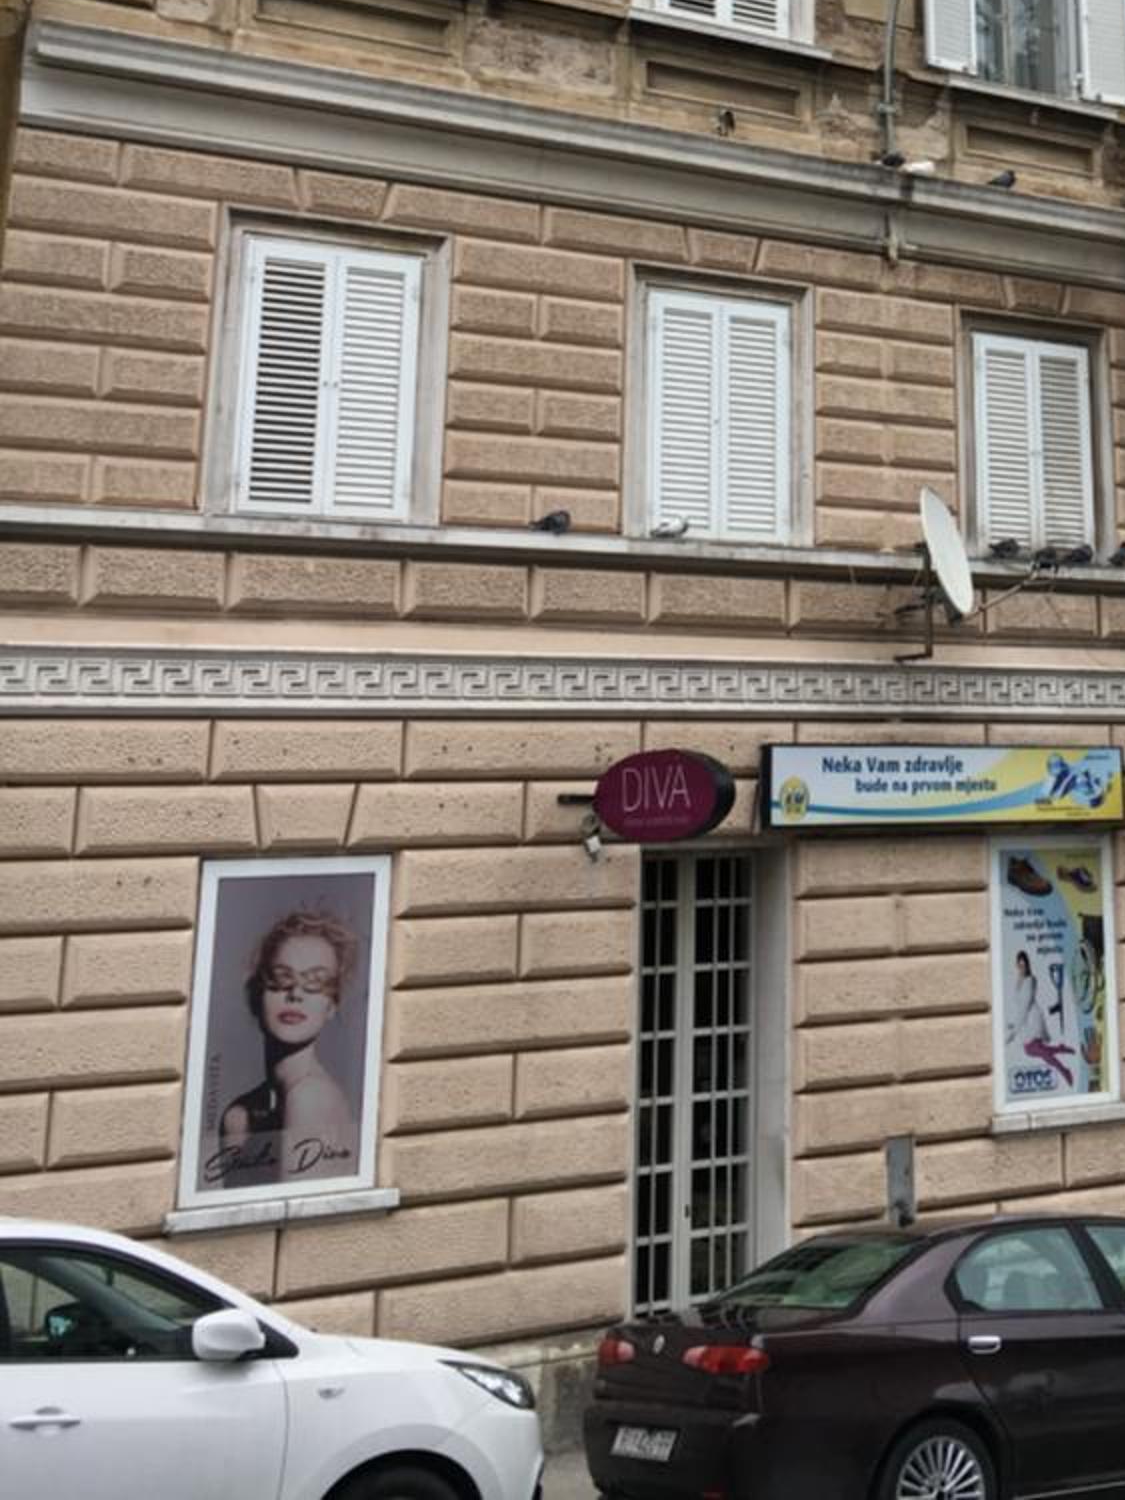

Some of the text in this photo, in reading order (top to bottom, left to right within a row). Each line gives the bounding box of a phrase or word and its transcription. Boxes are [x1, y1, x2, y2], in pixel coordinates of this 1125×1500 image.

[821, 755, 964, 777] Neka Vam zdravlje
[621, 764, 691, 812] DIVA
[854, 777, 997, 796] bude na prvom mjestu
[1013, 1069, 1053, 1090] OTOS
